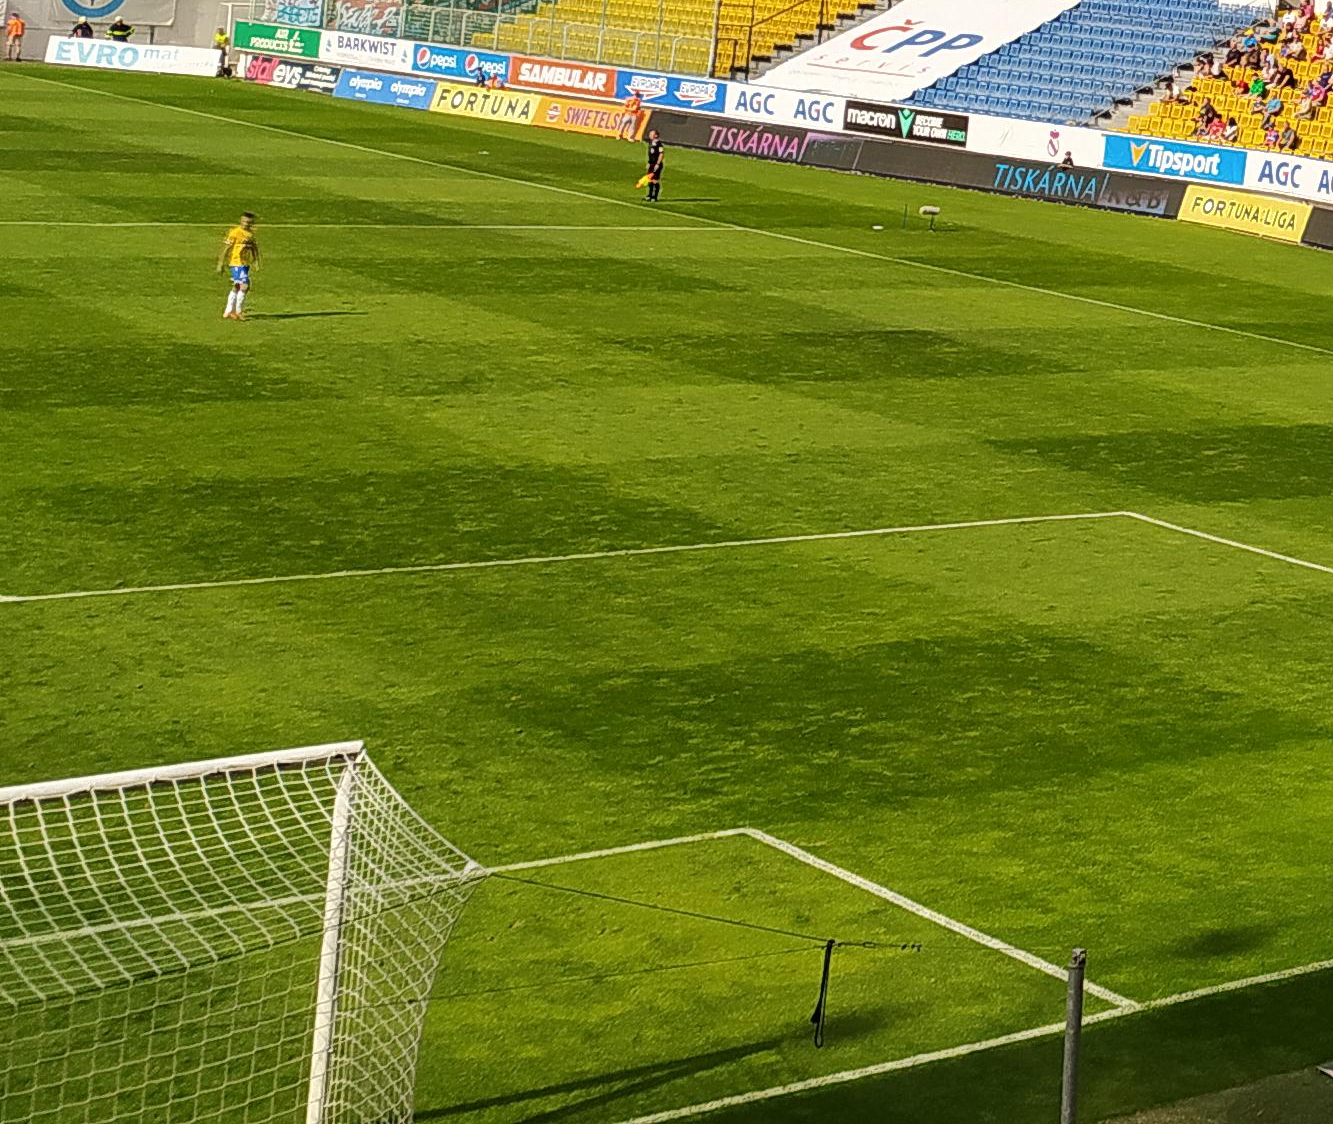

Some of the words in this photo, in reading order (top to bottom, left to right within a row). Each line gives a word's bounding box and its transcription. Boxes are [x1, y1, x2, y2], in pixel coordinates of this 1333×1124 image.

[250, 36, 288, 52] PRODUCTS
[337, 35, 397, 57] BARKWIST
[850, 18, 983, 58] ČPP
[55, 41, 140, 68] EVRO
[143, 47, 178, 61] mat
[430, 53, 457, 69] pepsi
[813, 53, 931, 74] servis
[518, 63, 608, 92] SAMBULAR
[437, 88, 531, 120] FORTUNA
[735, 91, 775, 115] AGC
[794, 99, 834, 123] AGC
[847, 108, 896, 129] macron
[707, 126, 801, 160] TISKÁRNA
[1148, 146, 1220, 176] Tipsport
[1258, 160, 1301, 189] AGC
[993, 164, 1097, 205] TISKÁRNA
